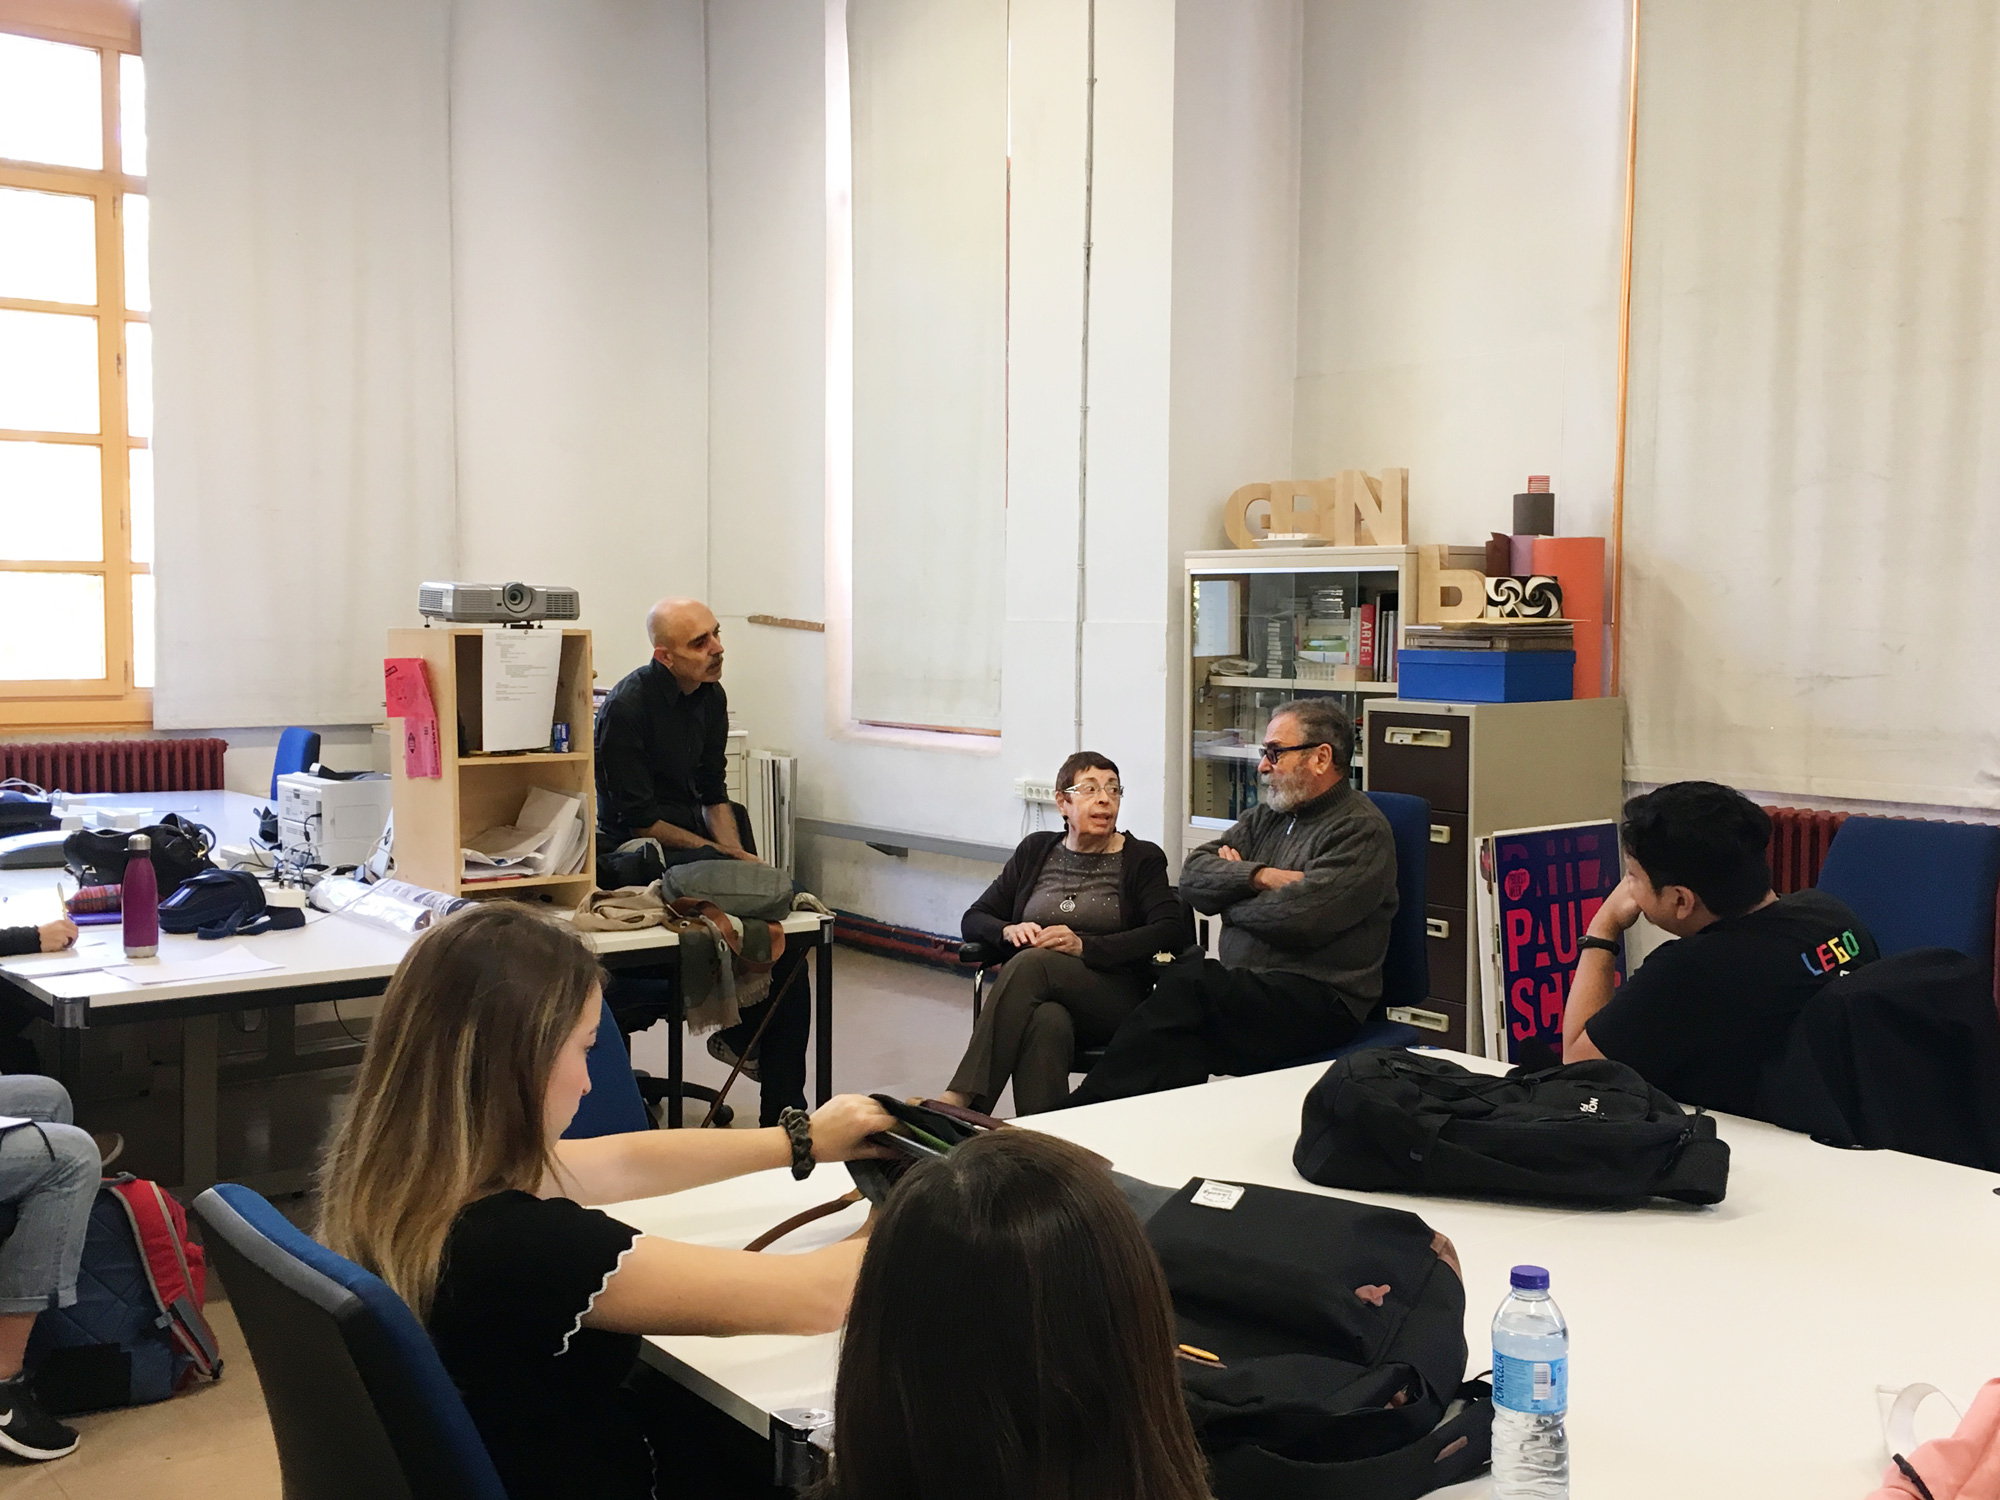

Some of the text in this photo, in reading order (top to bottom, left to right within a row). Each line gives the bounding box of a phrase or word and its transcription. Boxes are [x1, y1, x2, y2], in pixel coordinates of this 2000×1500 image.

[1361, 620, 1372, 653] ARTE
[1800, 930, 1860, 976] LEGO
[1494, 1355, 1505, 1404] FONTECELTA
